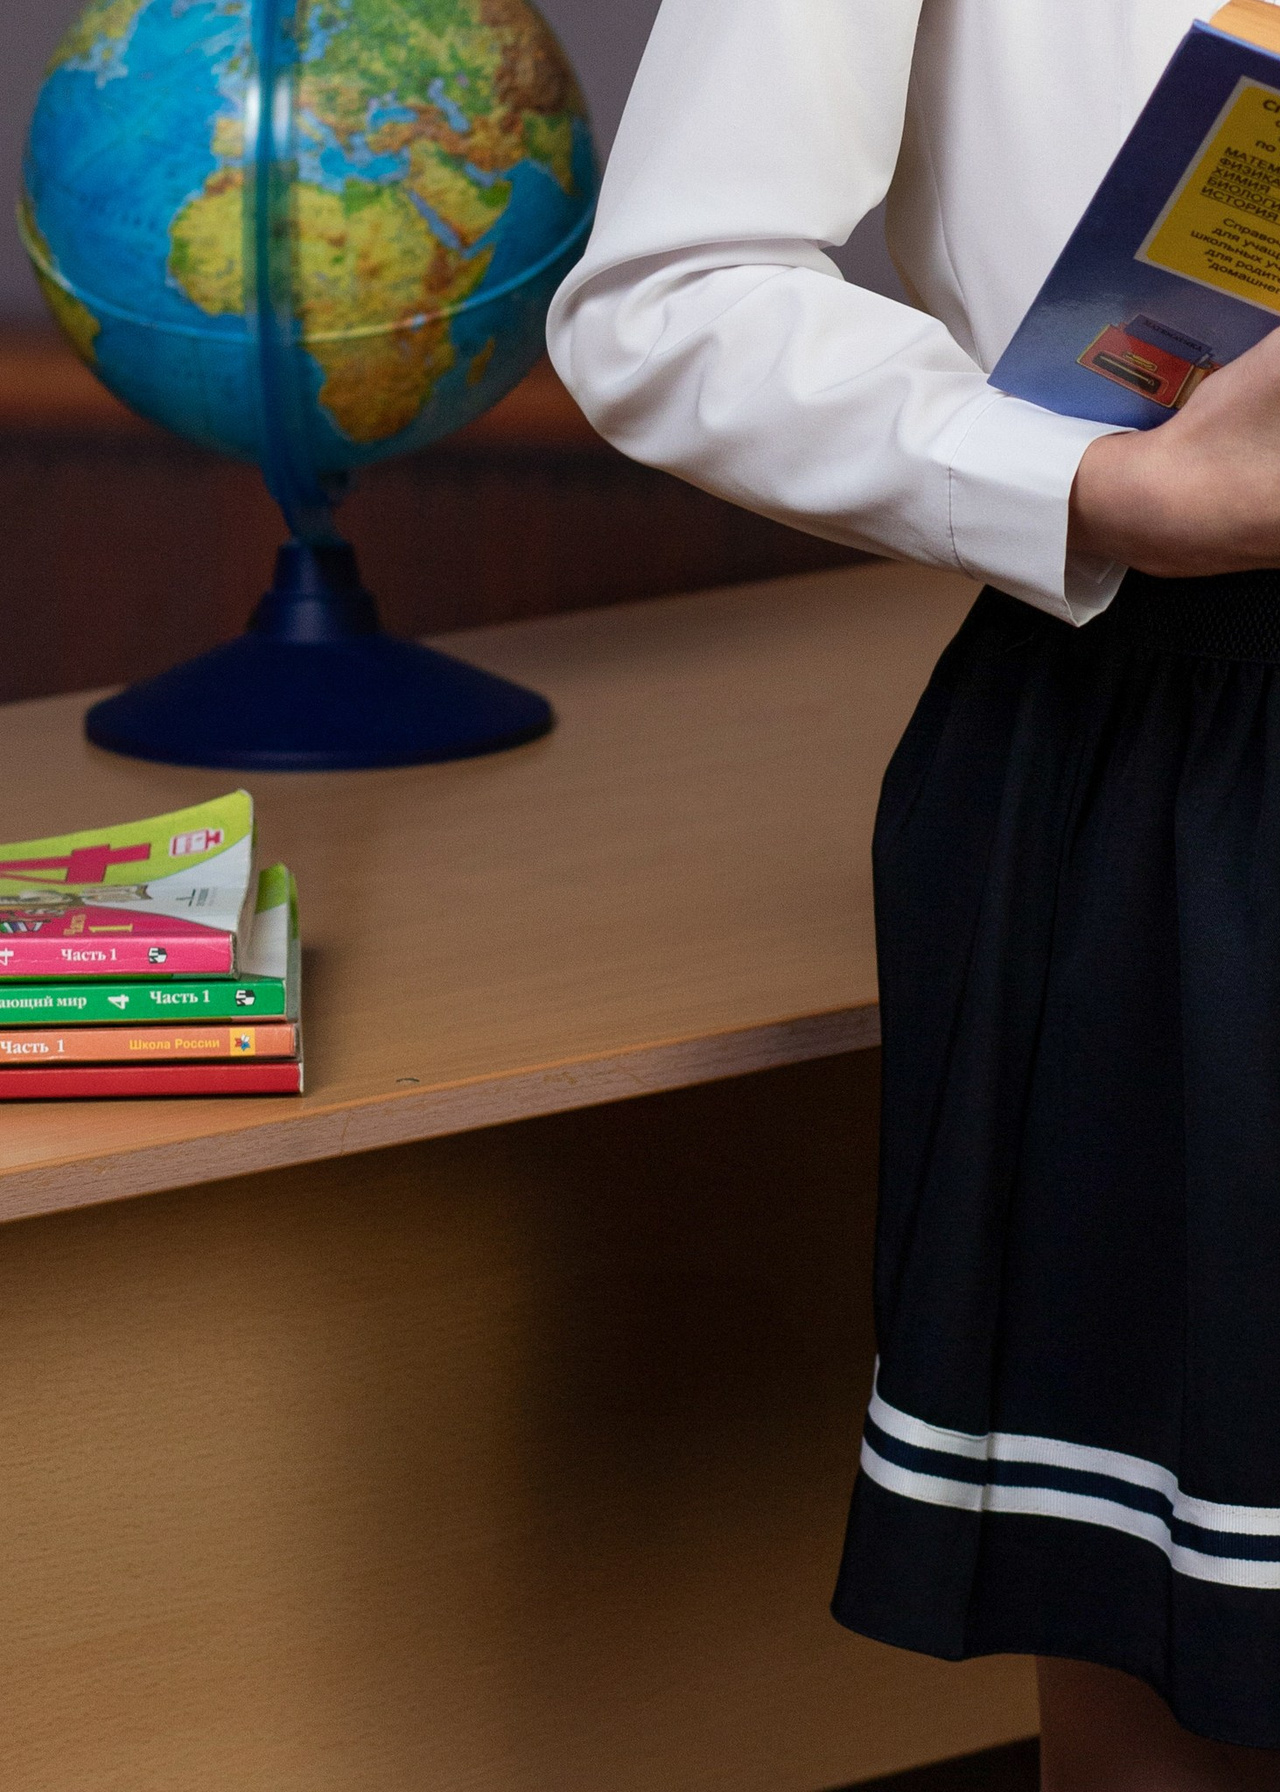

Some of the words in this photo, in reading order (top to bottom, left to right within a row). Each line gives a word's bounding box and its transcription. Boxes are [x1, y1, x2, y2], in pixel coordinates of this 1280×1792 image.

[1254, 139, 1277, 154] по
[1212, 164, 1271, 194] ХИМИЯ
[1200, 184, 1279, 222] ИСТОРИЯ
[1211, 225, 1241, 242] для
[1189, 228, 1263, 264] школьных
[1204, 246, 1231, 262] для
[61, 948, 106, 963] Часть
[110, 948, 117, 962] 1
[57, 997, 87, 1010] мир
[150, 990, 198, 1005] Часть
[203, 990, 210, 1003] 1
[0, 1041, 49, 1054] Часть
[56, 1039, 65, 1053] 1
[129, 1039, 171, 1051] Школа
[175, 1038, 220, 1049] России
